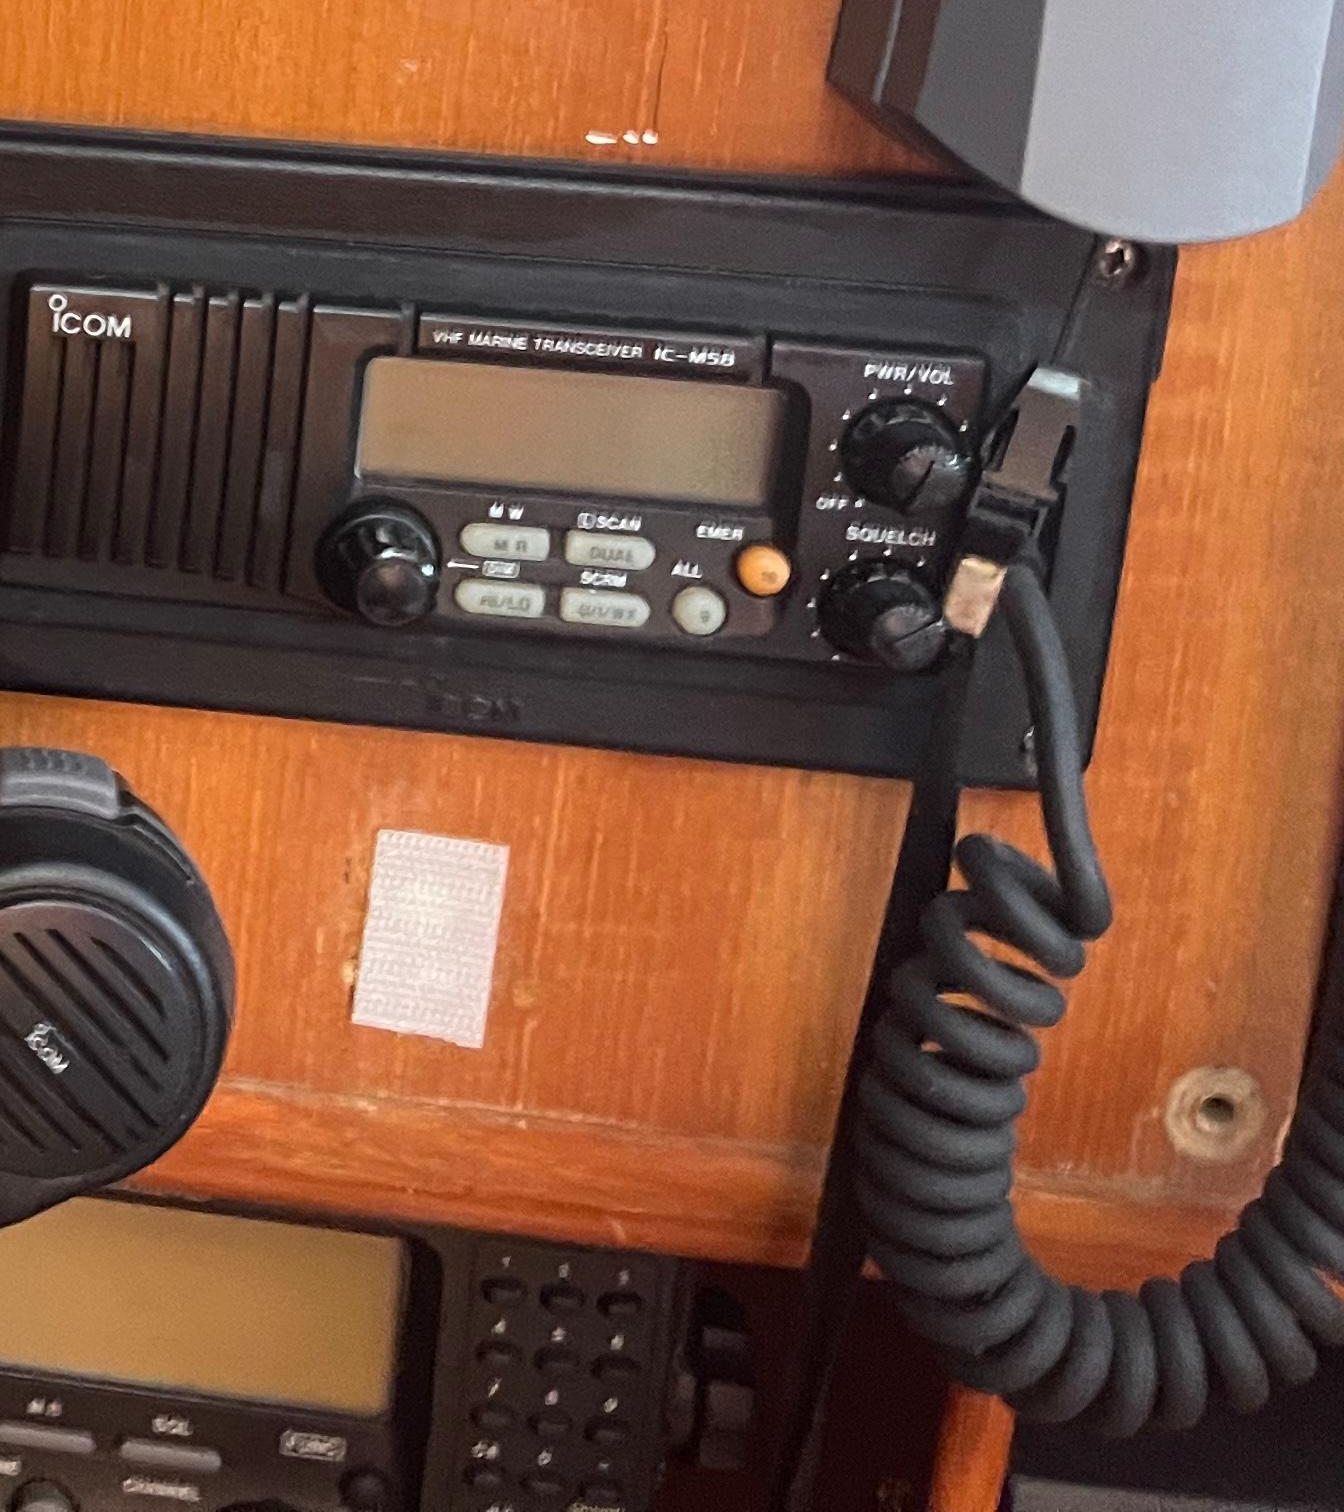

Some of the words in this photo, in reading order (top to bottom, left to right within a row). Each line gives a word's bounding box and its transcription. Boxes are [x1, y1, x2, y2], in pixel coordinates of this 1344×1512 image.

[432, 329, 463, 345] VHF
[468, 332, 528, 352] MARINE
[534, 337, 643, 360] TRANSCEIVER
[863, 362, 955, 387] PWR/VOL
[815, 494, 848, 512] OFF
[846, 522, 937, 547] SQUELCH
